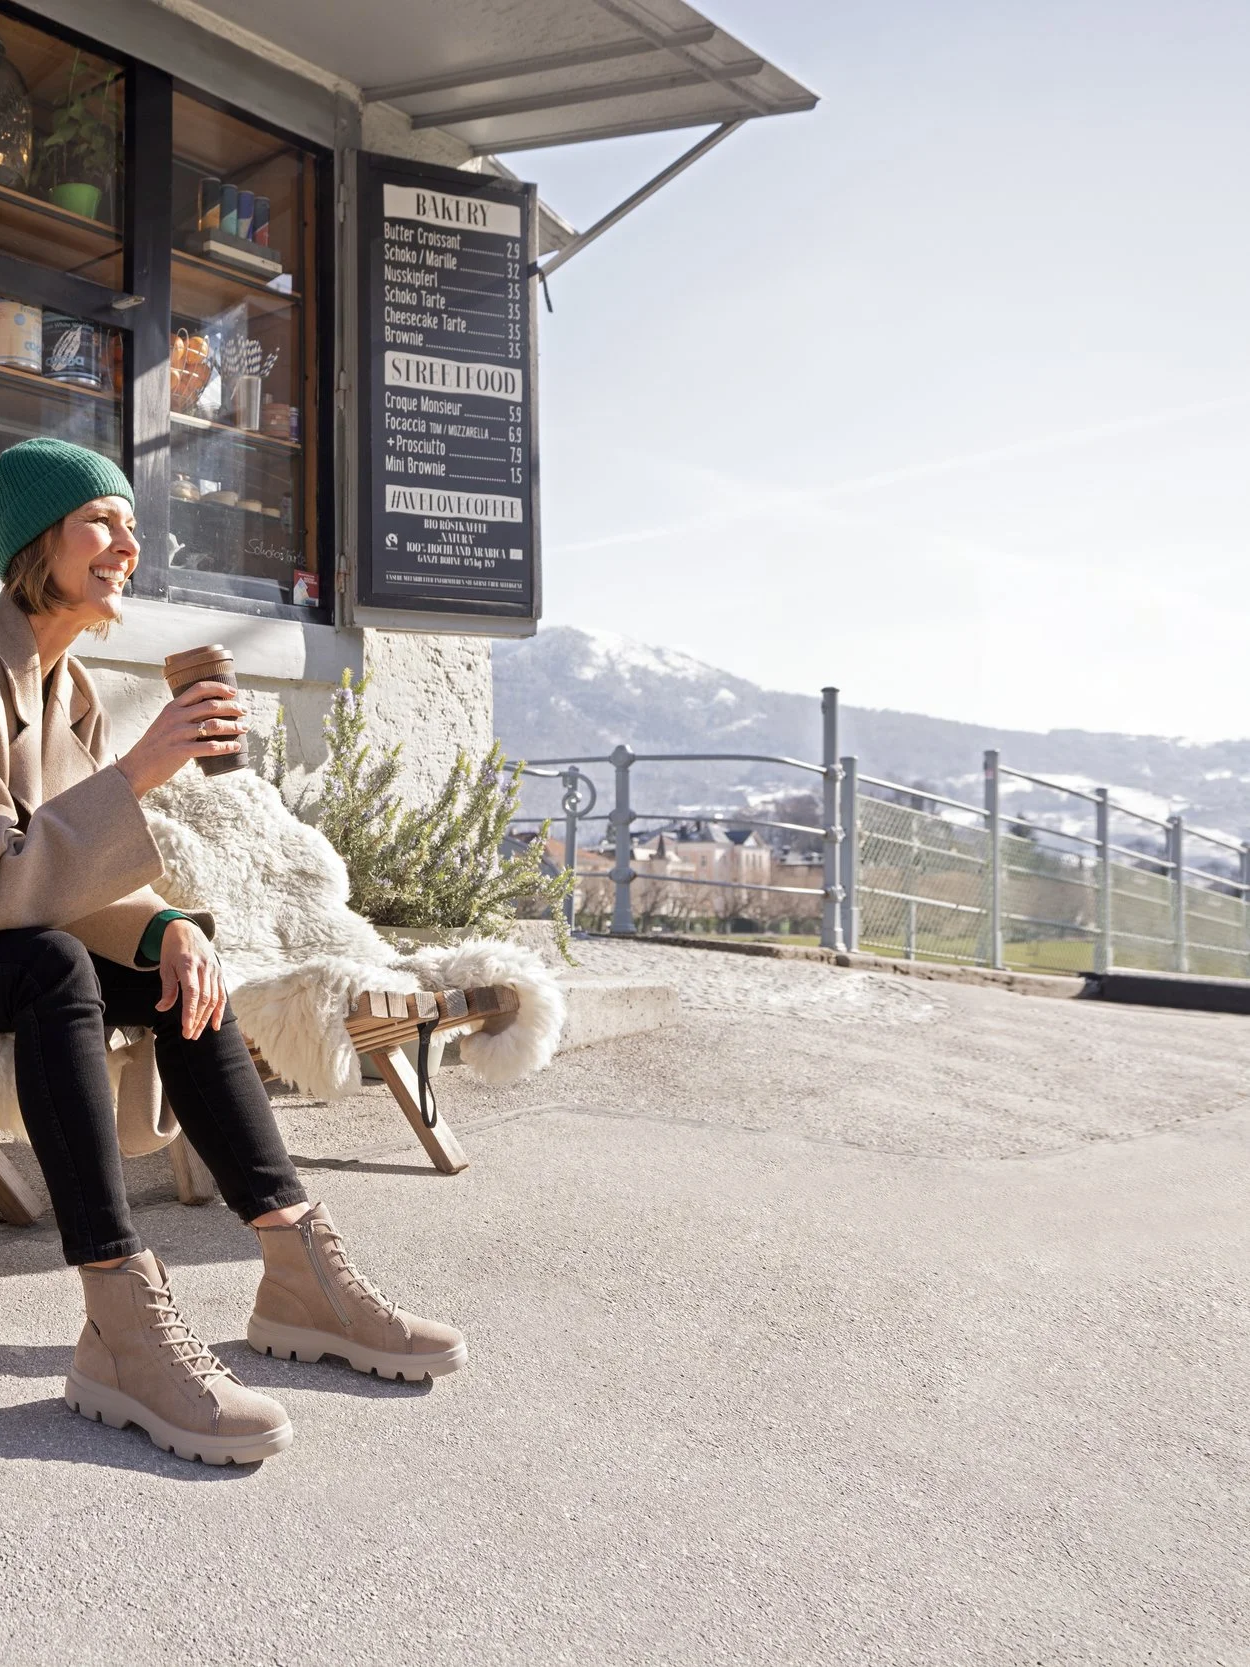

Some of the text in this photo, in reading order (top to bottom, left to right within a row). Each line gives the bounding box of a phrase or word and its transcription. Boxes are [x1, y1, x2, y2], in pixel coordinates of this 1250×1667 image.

[416, 193, 490, 227] BAKERY
[383, 222, 520, 259] Butter Croissant 2.9
[384, 243, 520, 279] Schoko / Marille 3.2
[384, 264, 521, 300] Nusskipferl 3.5
[384, 285, 521, 320] Schoko Tarte 3.5
[384, 306, 521, 340] Cheesecake Tarte 3.5
[384, 325, 521, 359] Brownie 3.5
[391, 357, 516, 395] STREETFOOD
[385, 391, 522, 423] Croque Monsieur 5.9
[385, 412, 426, 432] Focaccia
[429, 422, 442, 434] TOM
[448, 424, 489, 439] MOZZARELLA
[509, 426, 522, 443] 6.9
[387, 434, 522, 464] + Prosciutto 7.9
[385, 454, 522, 484] Mini Brownie 1.5
[391, 490, 518, 518] #WELOVECOFFEE
[424, 518, 438, 530] BIO
[427, 543, 471, 557] HOCHLAND
[473, 547, 506, 559] ARABICA
